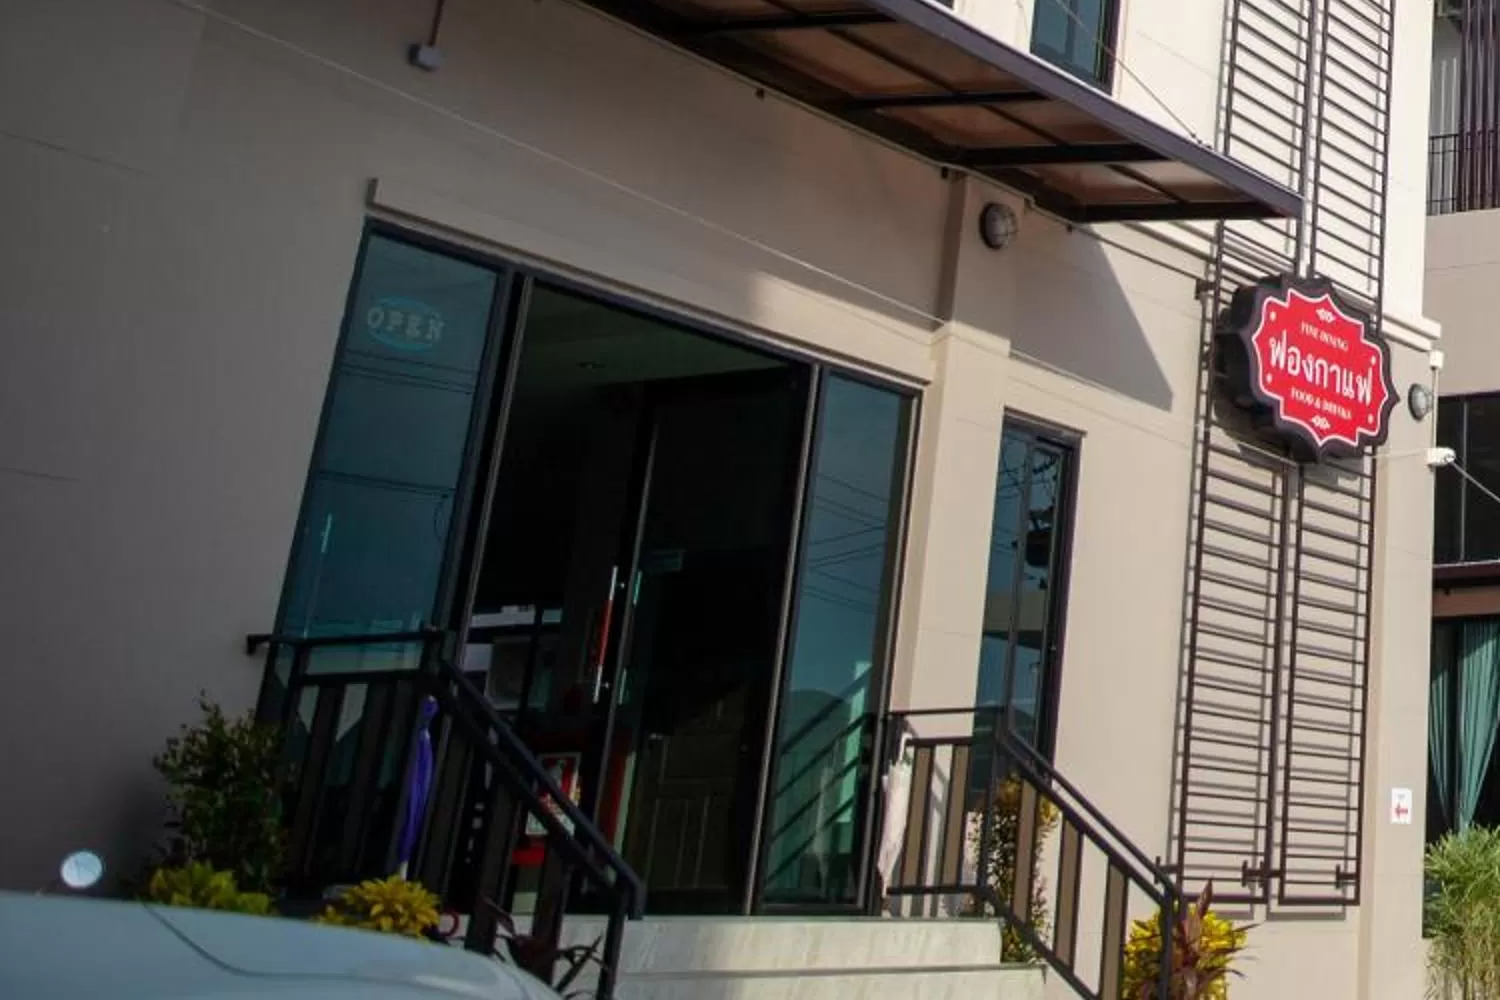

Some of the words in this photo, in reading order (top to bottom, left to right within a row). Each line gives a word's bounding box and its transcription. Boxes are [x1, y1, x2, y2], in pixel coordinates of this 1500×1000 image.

[367, 307, 446, 345] OPEN
[1268, 328, 1373, 406] ฟองกาแฟ
